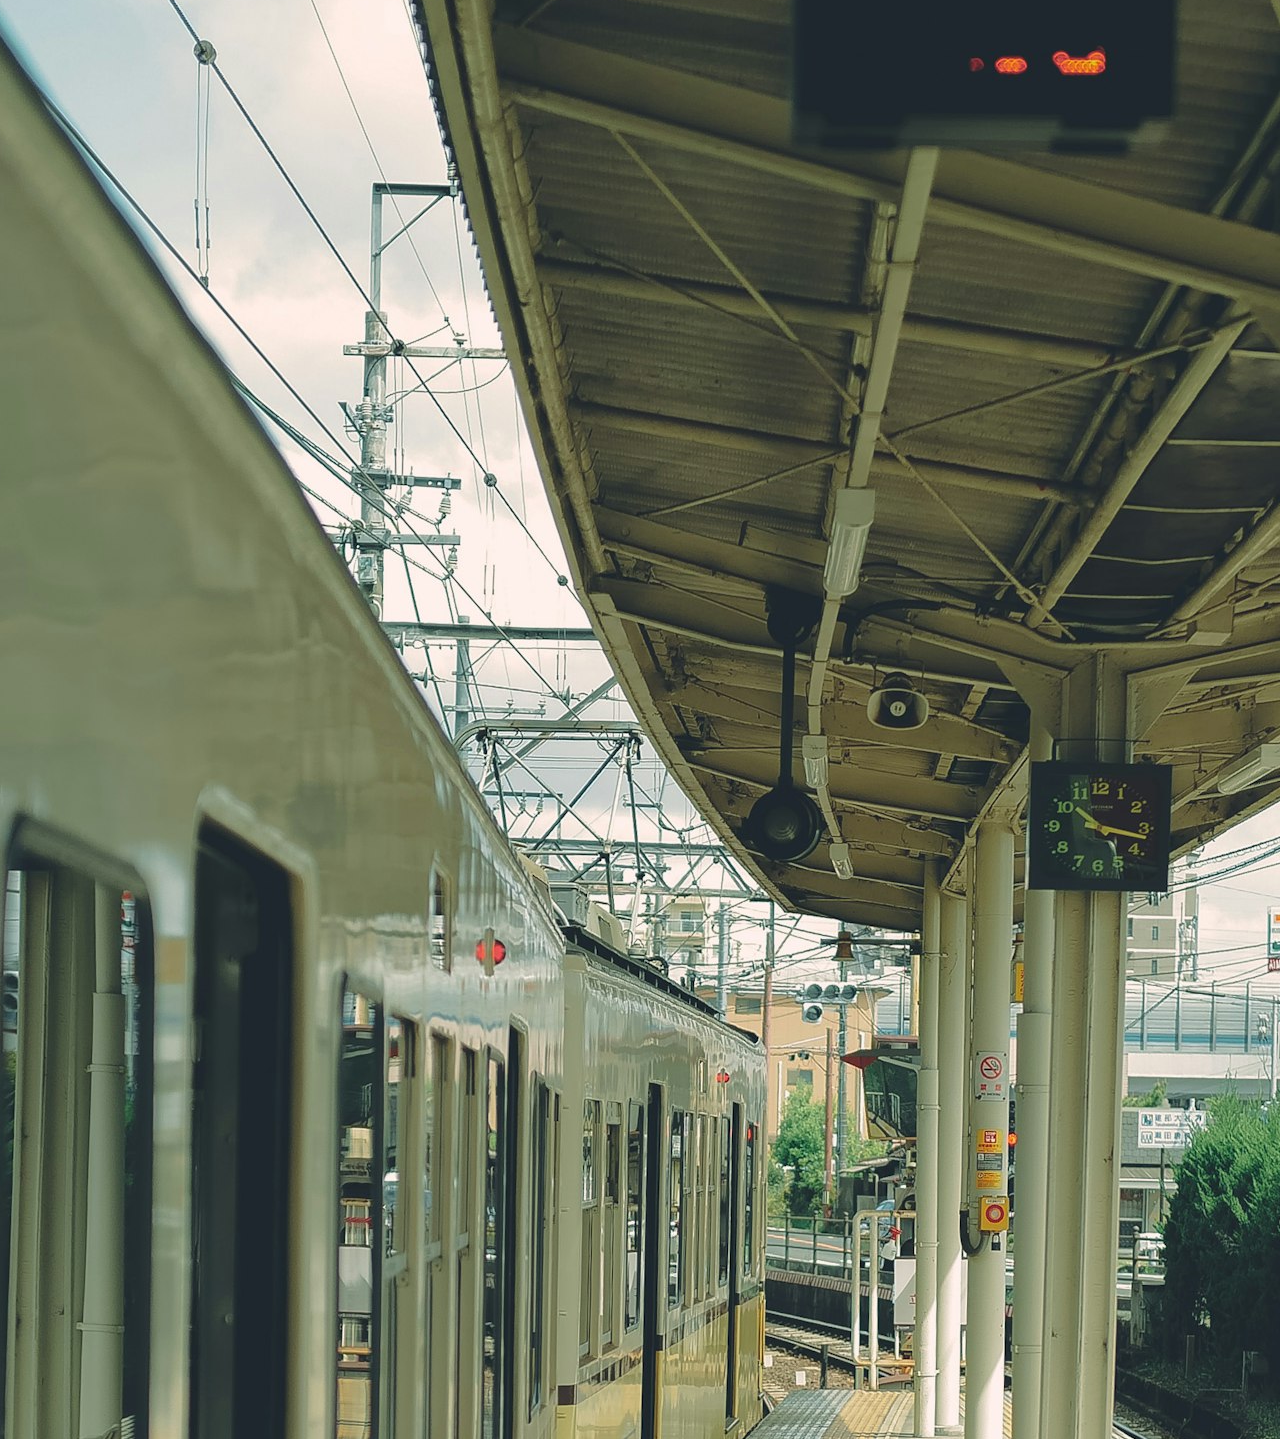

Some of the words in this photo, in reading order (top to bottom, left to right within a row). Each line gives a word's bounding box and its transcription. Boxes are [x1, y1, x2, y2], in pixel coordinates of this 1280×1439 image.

[1072, 787, 1088, 800] 11
[1091, 782, 1109, 795] 12
[1117, 787, 1124, 800] 1
[1057, 801, 1074, 813] 10
[1130, 801, 1142, 813] 2
[1048, 820, 1060, 832] 9
[1138, 822, 1150, 834] 3
[1057, 841, 1068, 853] 8
[1128, 843, 1140, 855] 4
[1073, 855, 1085, 867] 7
[1092, 859, 1103, 872] 6
[1112, 856, 1124, 868] 5
